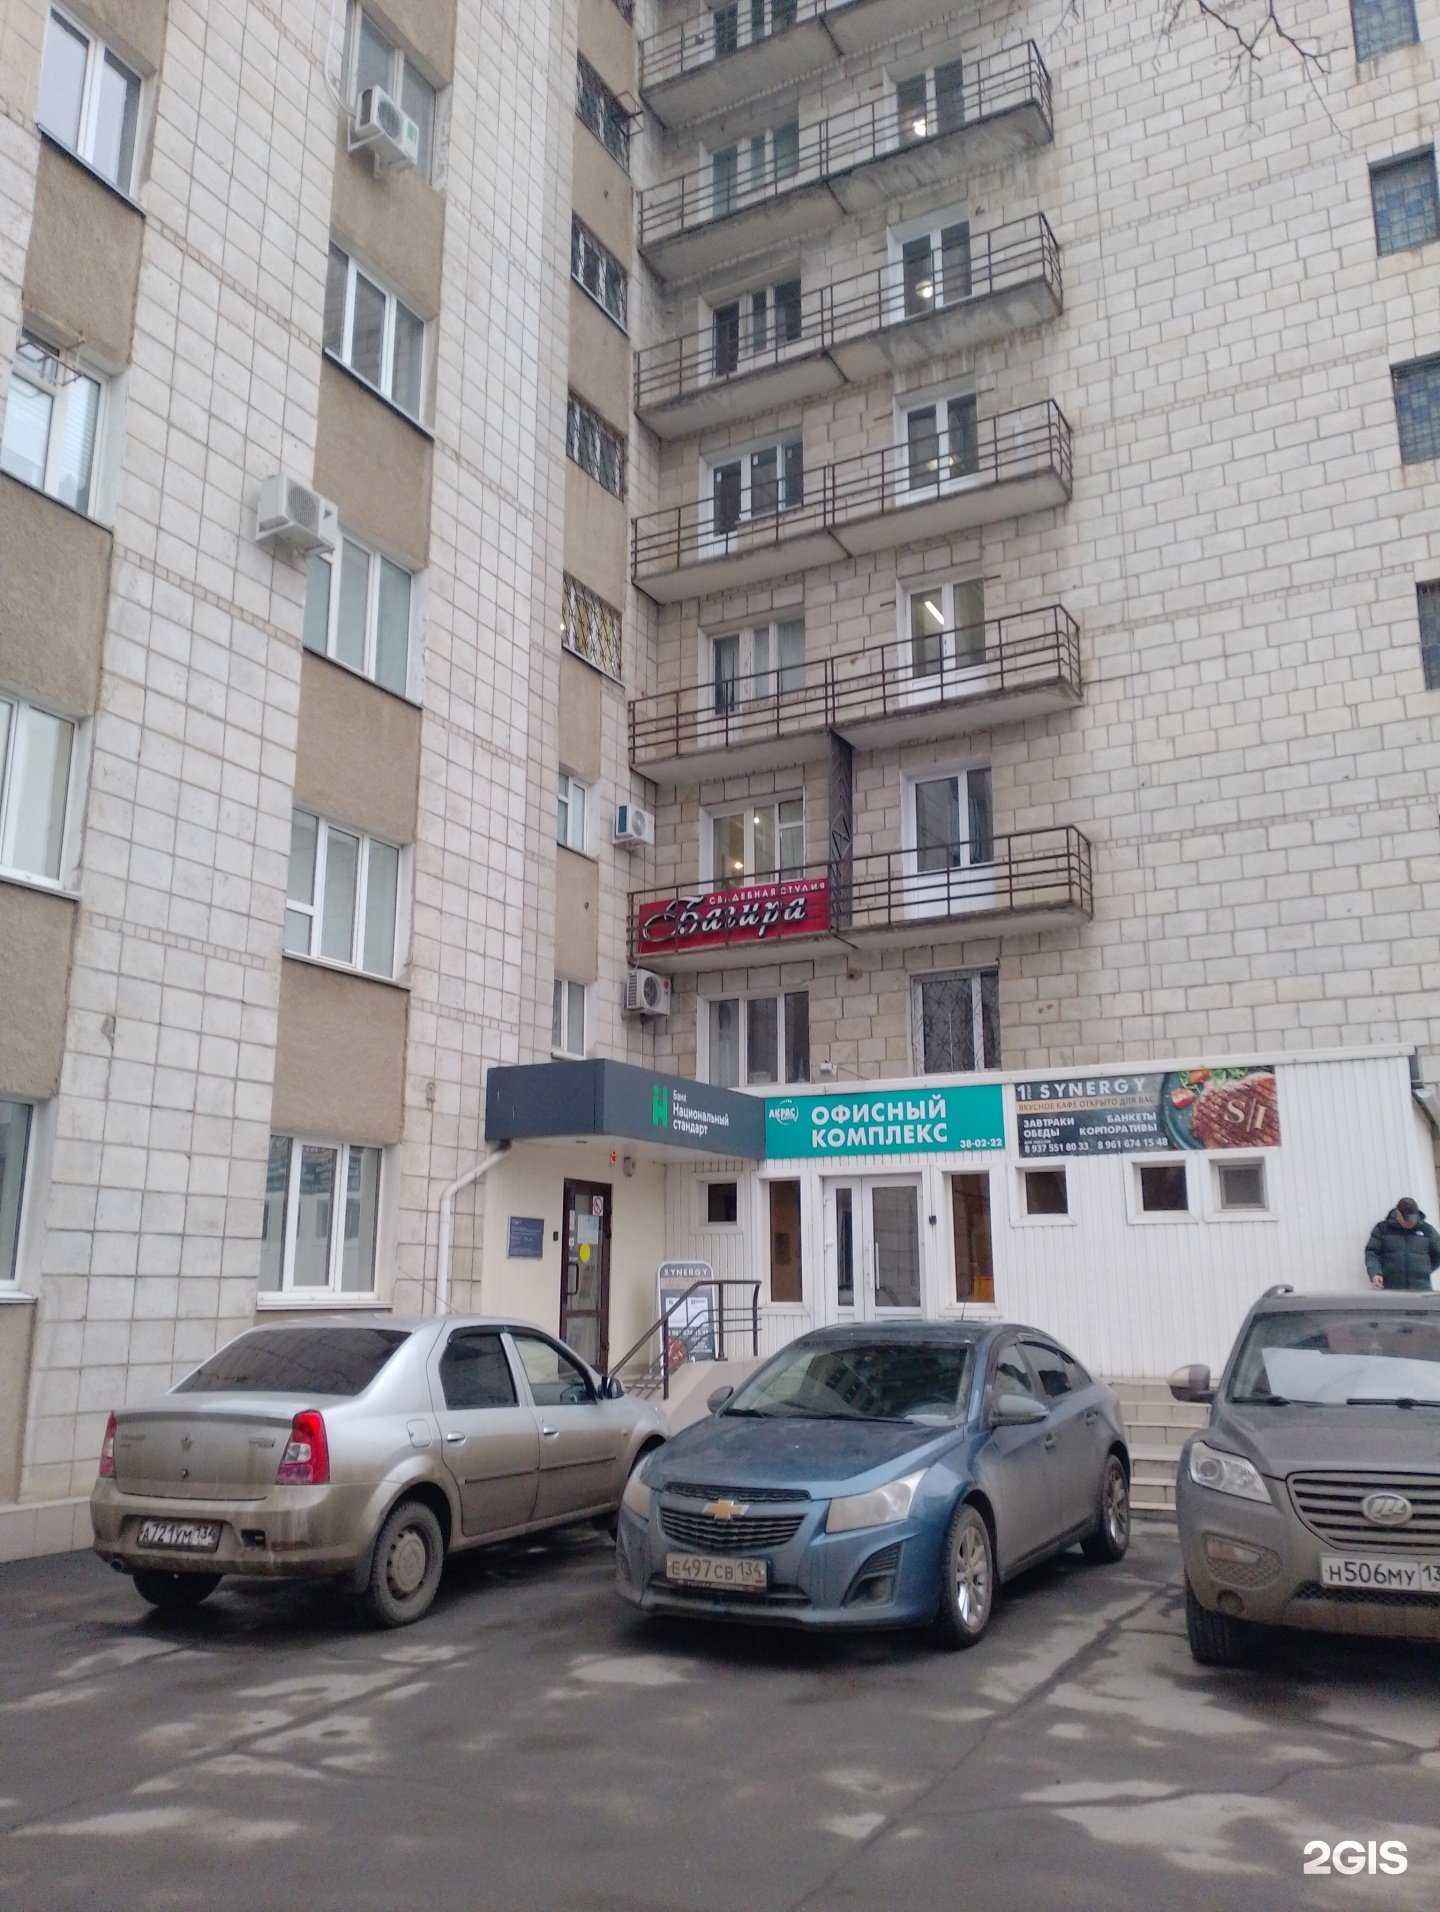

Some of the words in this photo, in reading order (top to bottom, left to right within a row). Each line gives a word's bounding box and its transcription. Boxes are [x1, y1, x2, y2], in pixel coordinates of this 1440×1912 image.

[1040, 1078, 1145, 1099] SYNERGY
[673, 1102, 730, 1127] Национальный
[811, 1094, 947, 1125] ОФИСНЫЙ
[1023, 1117, 1075, 1128] ЗАВТРАКИ
[1107, 1112, 1157, 1123] БАНКЕТЫ
[673, 1119, 708, 1137] стандарт
[811, 1122, 948, 1149] КОМПЛЕКС
[1023, 1128, 1060, 1139] ОБЕДЫ
[1079, 1123, 1158, 1136] КОРПОРАТИВЫ
[1031, 1143, 1047, 1153] 937
[1144, 1137, 1154, 1147] 15
[1156, 1136, 1168, 1146] 48
[664, 1268, 708, 1277] SYNERGY
[672, 1556, 734, 1581] Е497СВ
[738, 1559, 762, 1576] 134
[1329, 1561, 1416, 1586] Н506МУ
